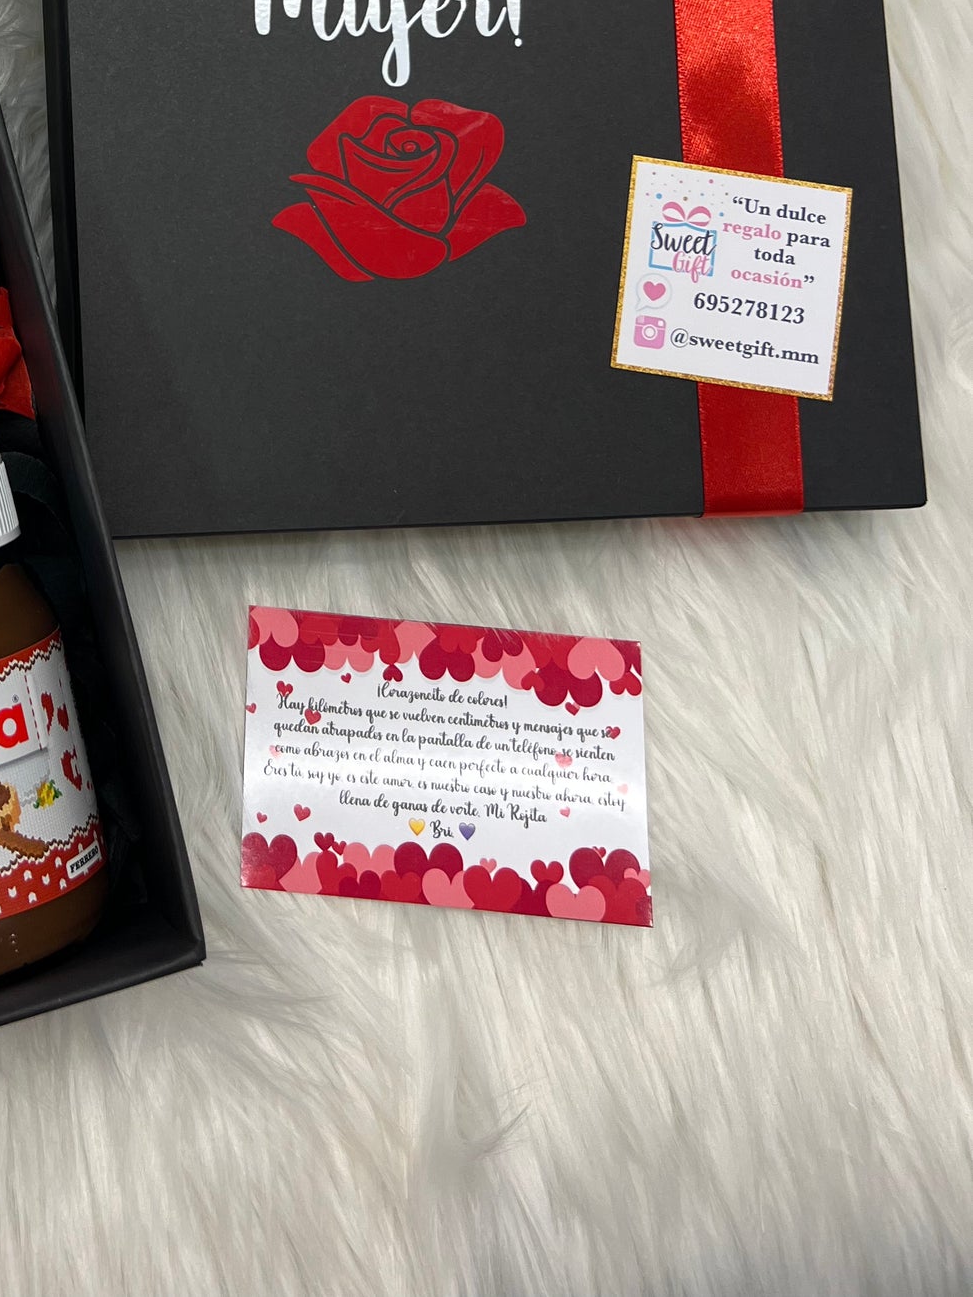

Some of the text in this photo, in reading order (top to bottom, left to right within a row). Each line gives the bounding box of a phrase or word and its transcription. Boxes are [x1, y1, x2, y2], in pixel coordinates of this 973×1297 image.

[776, 202, 827, 224] dulce
[650, 223, 717, 256] Sweet
[722, 222, 831, 248] regalo para
[672, 251, 712, 283] Gift
[754, 247, 795, 265] toda
[694, 292, 805, 325] 695278123
[670, 327, 819, 365] @sweetgift.mm
[448, 689, 464, 703] de
[467, 691, 508, 708] colores!
[276, 692, 305, 715] Hay
[365, 709, 387, 723] que
[389, 710, 400, 720] se
[403, 708, 445, 724] vuelven
[512, 722, 521, 735] y
[523, 723, 573, 741] mensajes
[576, 728, 599, 743] que
[601, 728, 611, 738] se
[273, 719, 320, 737] quedan
[321, 721, 382, 743] atrapados
[385, 732, 399, 742] en
[401, 728, 416, 743] la
[418, 732, 473, 750] pantalla
[473, 735, 492, 750] de
[494, 742, 510, 751] un
[561, 748, 572, 758] se
[575, 745, 615, 761] sienten
[275, 744, 300, 754] como
[303, 741, 349, 762] abrazos
[352, 752, 367, 761] en
[369, 747, 381, 763] el
[383, 750, 415, 765] alma
[417, 758, 426, 771] y
[429, 758, 456, 770] caen
[459, 758, 506, 778] perfecto
[509, 767, 519, 775] a
[521, 762, 579, 785] cualquier
[263, 759, 287, 777] Eres
[307, 770, 323, 784] soy
[346, 775, 356, 785] es
[359, 769, 378, 785] este
[417, 780, 427, 790] es
[430, 778, 470, 793] nuestro
[473, 785, 496, 796] caso
[500, 788, 509, 801] y
[511, 785, 551, 801] nuestro
[598, 791, 627, 812] estoy
[339, 789, 371, 807] llena
[373, 793, 389, 808] de
[391, 799, 427, 817] ganas
[430, 799, 448, 814] de
[483, 802, 505, 819] Mi
[507, 802, 548, 829] Rojita
[70, 845, 99, 874] FERRERO
